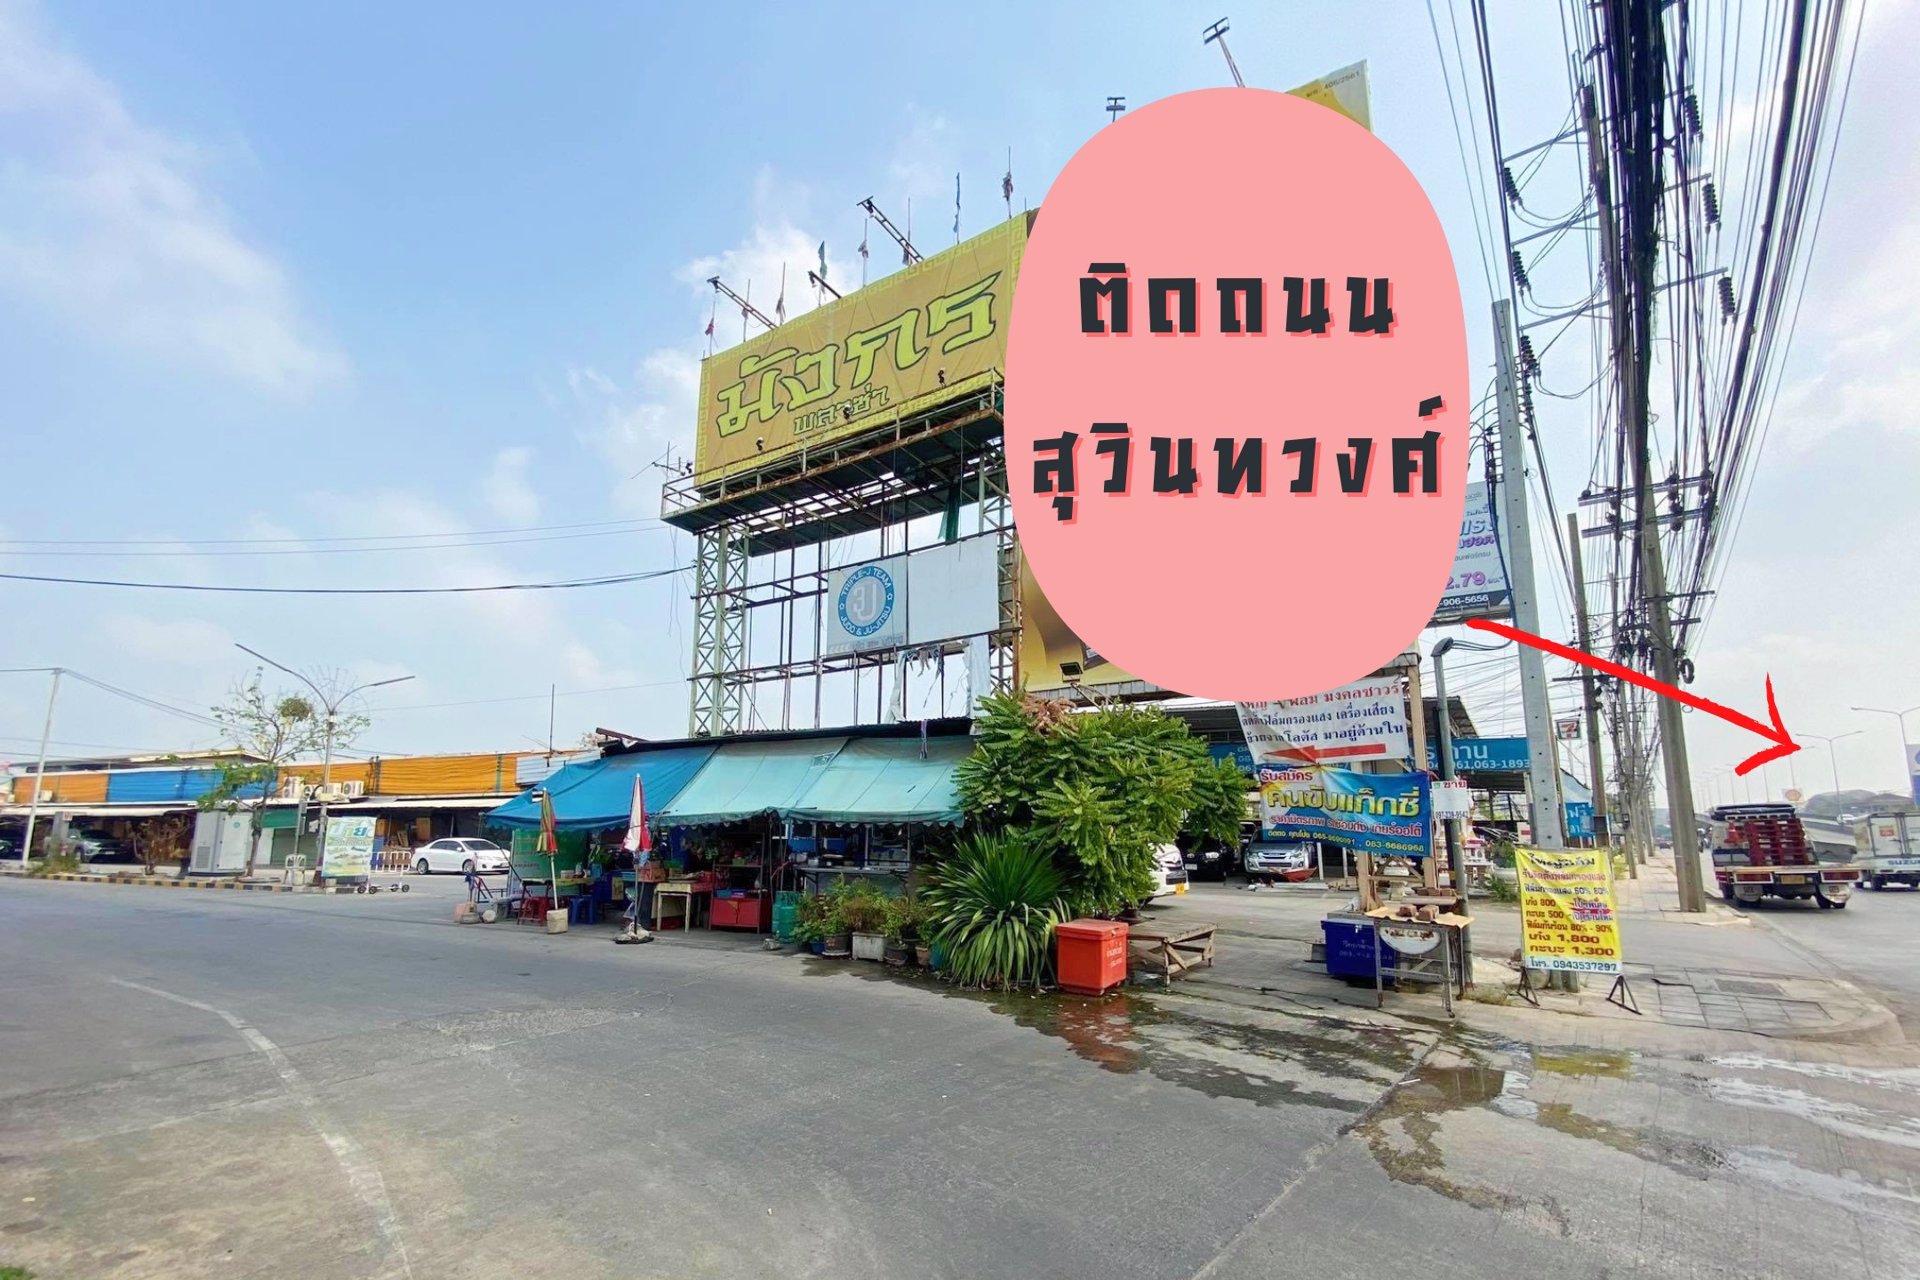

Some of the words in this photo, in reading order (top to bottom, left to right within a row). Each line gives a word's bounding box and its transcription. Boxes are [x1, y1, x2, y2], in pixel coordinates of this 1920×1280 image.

[715, 270, 1003, 439] มังกร
[873, 567, 891, 588] TEAM
[1336, 702, 1396, 720] เครื่องเสียง
[1323, 720, 1404, 742] มาอยู่ด้านใน
[1260, 769, 1313, 783] รับสมัคร
[1266, 784, 1421, 818] คนขับแท็กซี่
[1548, 910, 1564, 918] 500
[1557, 934, 1600, 943] 1,800
[1552, 960, 1617, 971] 0943537297
